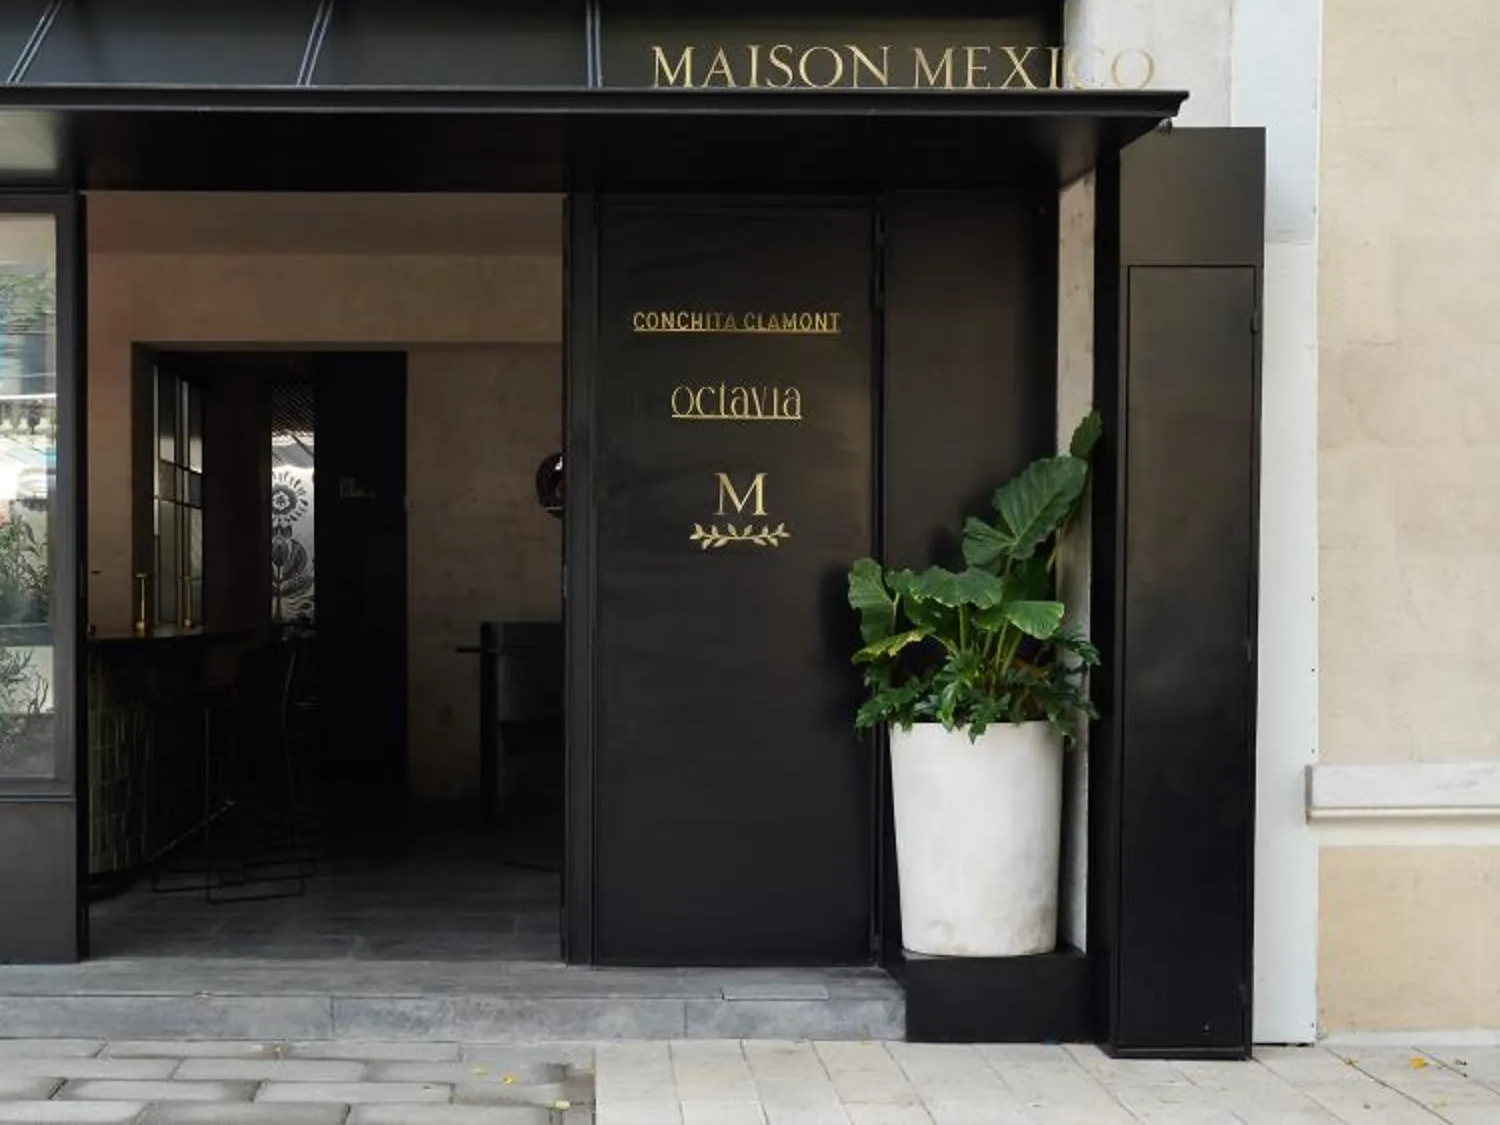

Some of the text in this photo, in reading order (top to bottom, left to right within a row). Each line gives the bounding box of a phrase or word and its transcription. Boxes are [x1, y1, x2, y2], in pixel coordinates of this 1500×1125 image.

[652, 44, 1156, 89] MAISON MEXICO
[632, 311, 842, 332] CONCHITA CLAMONT
[712, 472, 768, 516] M
